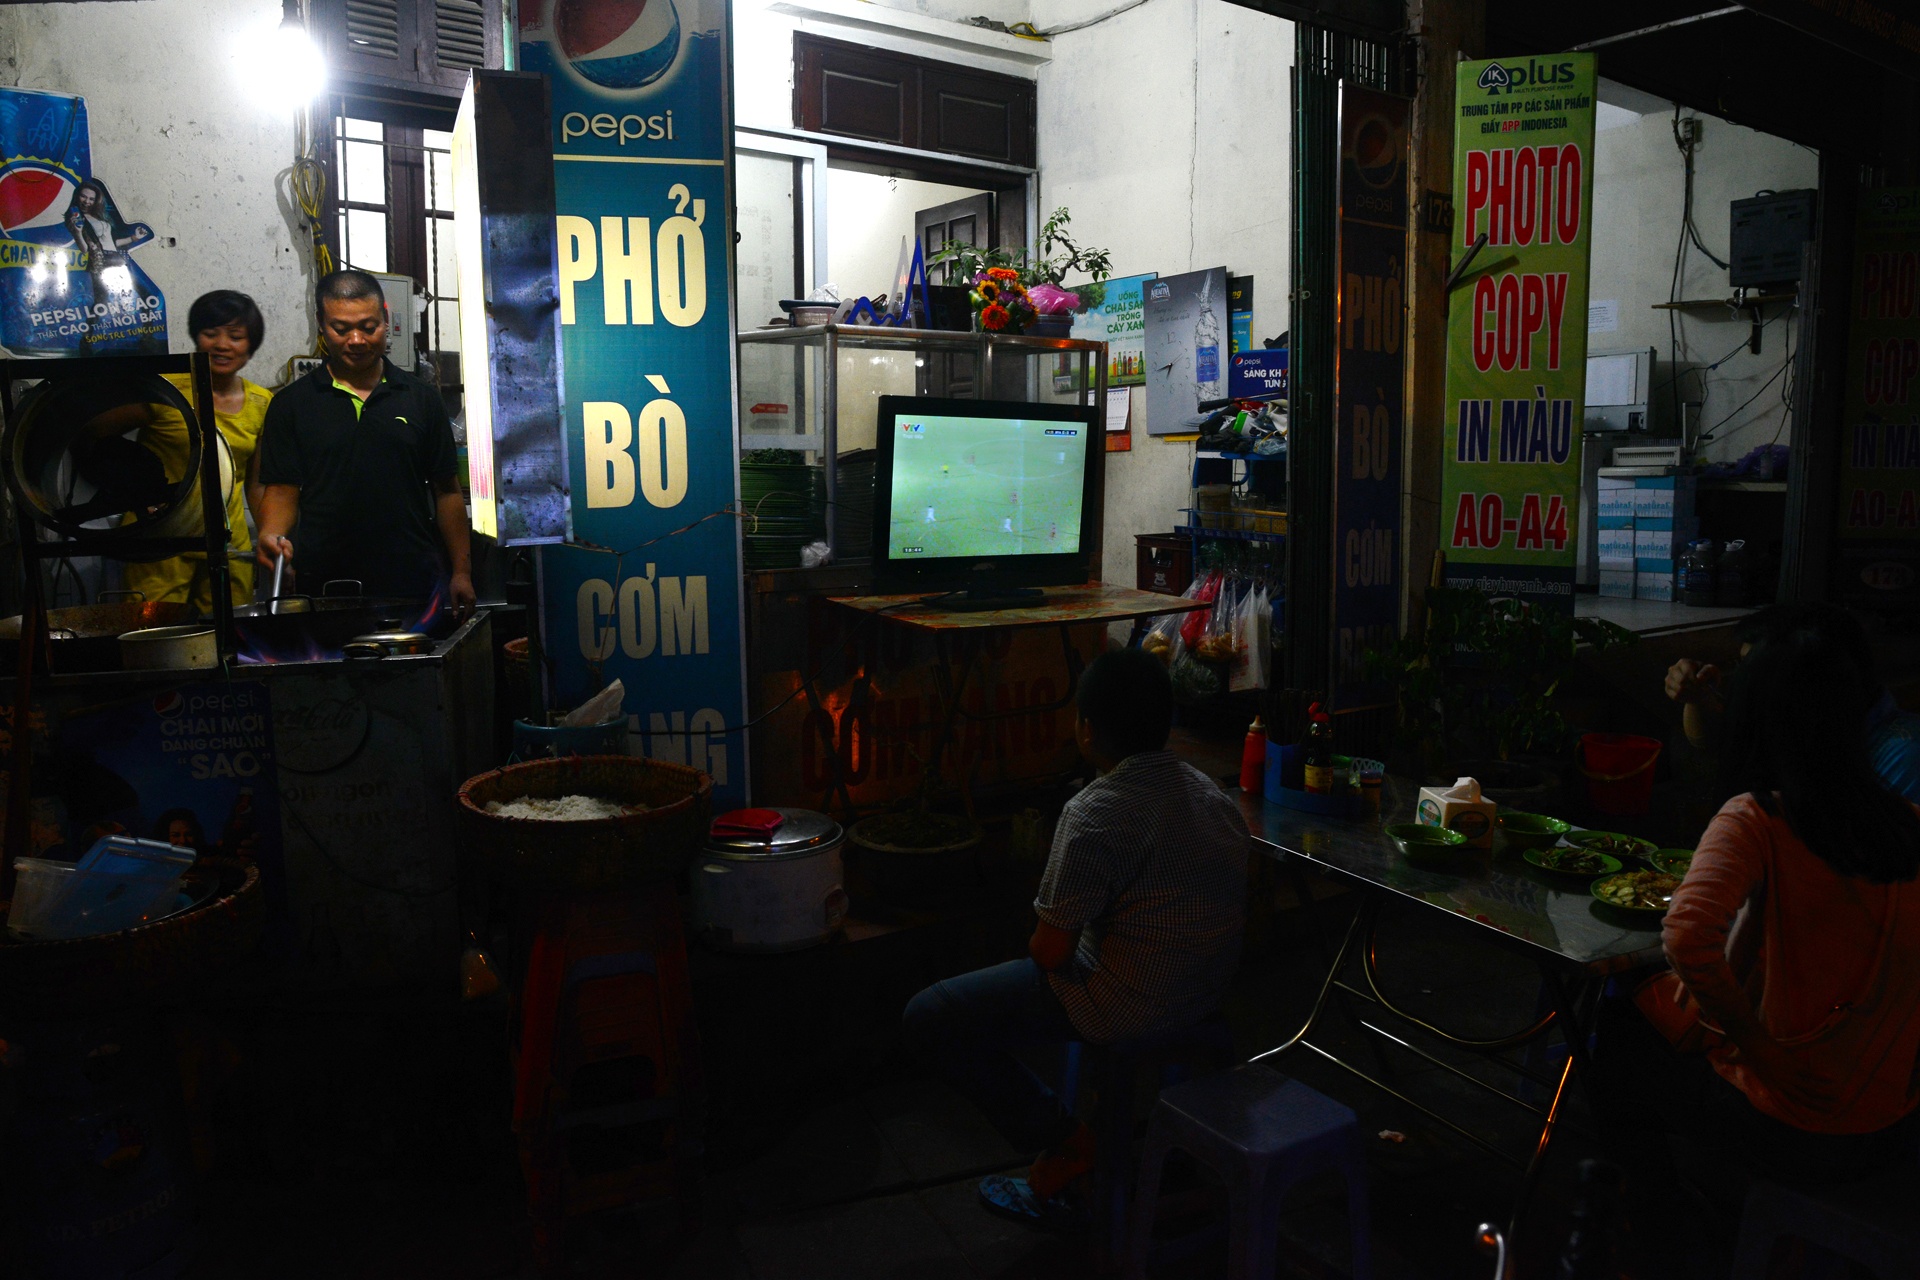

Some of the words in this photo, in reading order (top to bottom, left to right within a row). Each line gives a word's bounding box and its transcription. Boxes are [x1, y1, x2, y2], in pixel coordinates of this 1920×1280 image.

[1506, 59, 1575, 94] plus
[1462, 104, 1488, 117] TRUNG
[1491, 100, 1508, 115] TÂM
[1511, 101, 1522, 113] PP
[1524, 98, 1541, 112] CÁC
[1544, 94, 1562, 111] SẢN
[562, 109, 673, 146] pepsi
[1481, 118, 1501, 134] GIẤY
[1501, 120, 1520, 133] APP
[1521, 117, 1567, 132] INDONESIA
[1464, 142, 1582, 248] PHOTO
[556, 183, 707, 328] PHỞ
[30, 308, 82, 326] PEPSI
[86, 302, 120, 319] LON
[1105, 302, 1126, 314] CHAI
[1472, 272, 1570, 373] COPY
[59, 322, 90, 336] CAO
[1244, 357, 1262, 366] pepsi
[1352, 386, 1389, 481] BÒ
[1456, 399, 1492, 463] IN
[1498, 385, 1573, 465] MÀU
[582, 374, 688, 509] BÒ
[1446, 576, 1572, 595] wwwgiayhuyanh.com
[576, 562, 710, 662] CƠM
[189, 690, 254, 714] pepsi
[160, 717, 216, 736] CHAI
